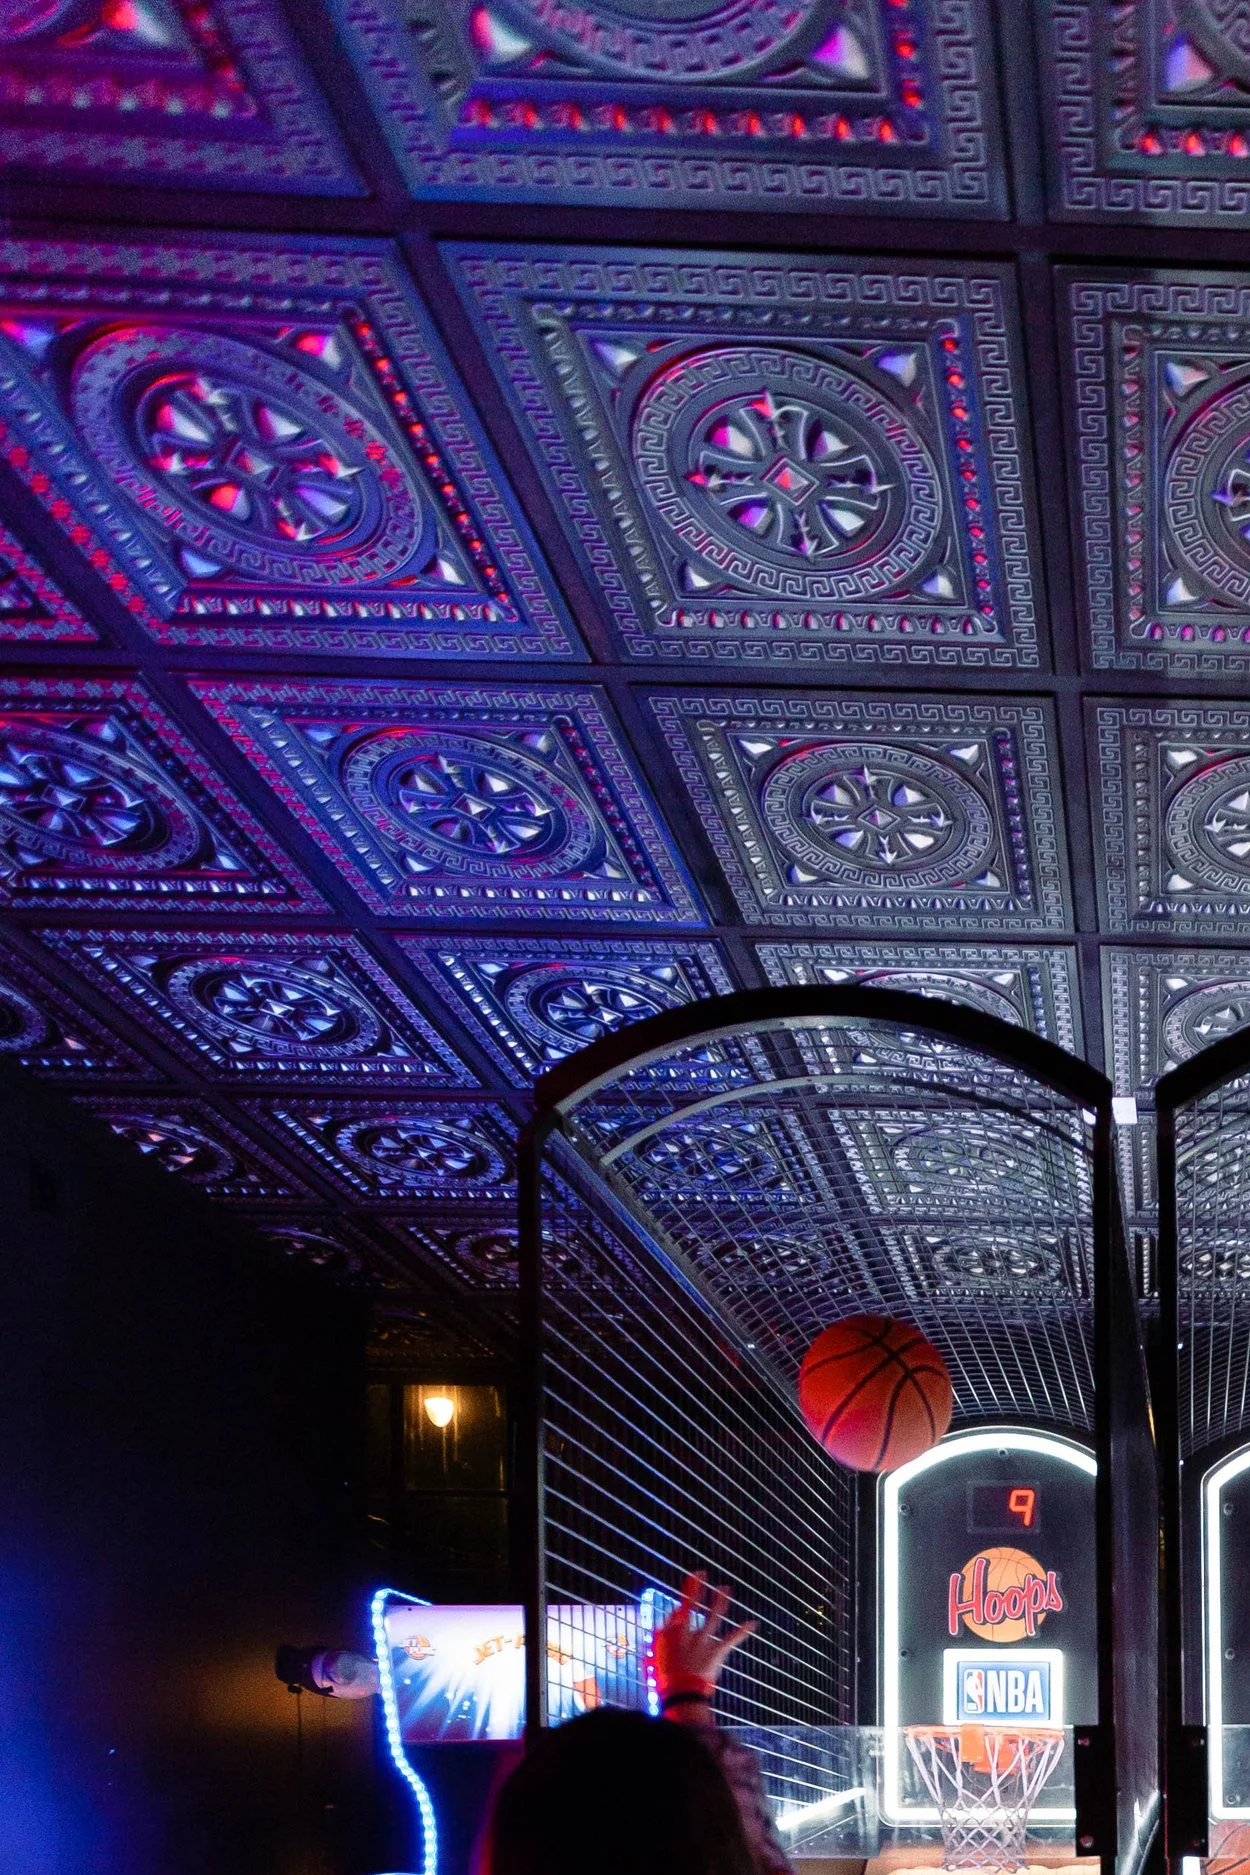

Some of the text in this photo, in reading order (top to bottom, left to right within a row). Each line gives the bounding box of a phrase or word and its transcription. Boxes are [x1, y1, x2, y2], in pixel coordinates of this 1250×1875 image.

[1008, 1489, 1034, 1527] 9
[948, 1557, 1063, 1636] Hoops
[986, 1668, 1044, 1713] NBA
